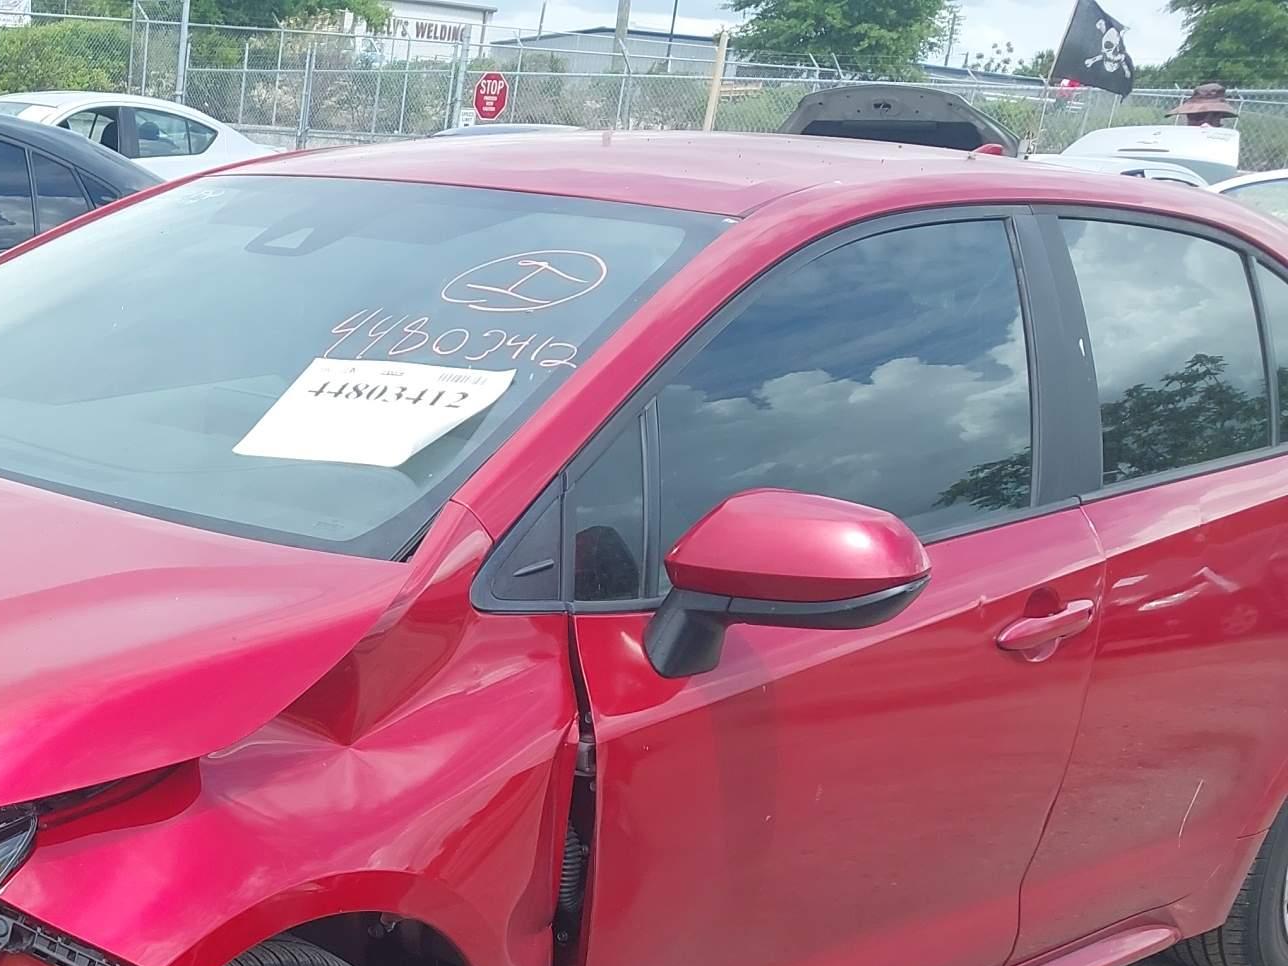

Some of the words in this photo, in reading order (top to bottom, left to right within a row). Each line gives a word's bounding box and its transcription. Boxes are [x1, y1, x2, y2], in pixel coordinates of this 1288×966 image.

[480, 80, 504, 94] STOP
[323, 307, 578, 368] 44803412
[308, 381, 469, 408] 44803412
